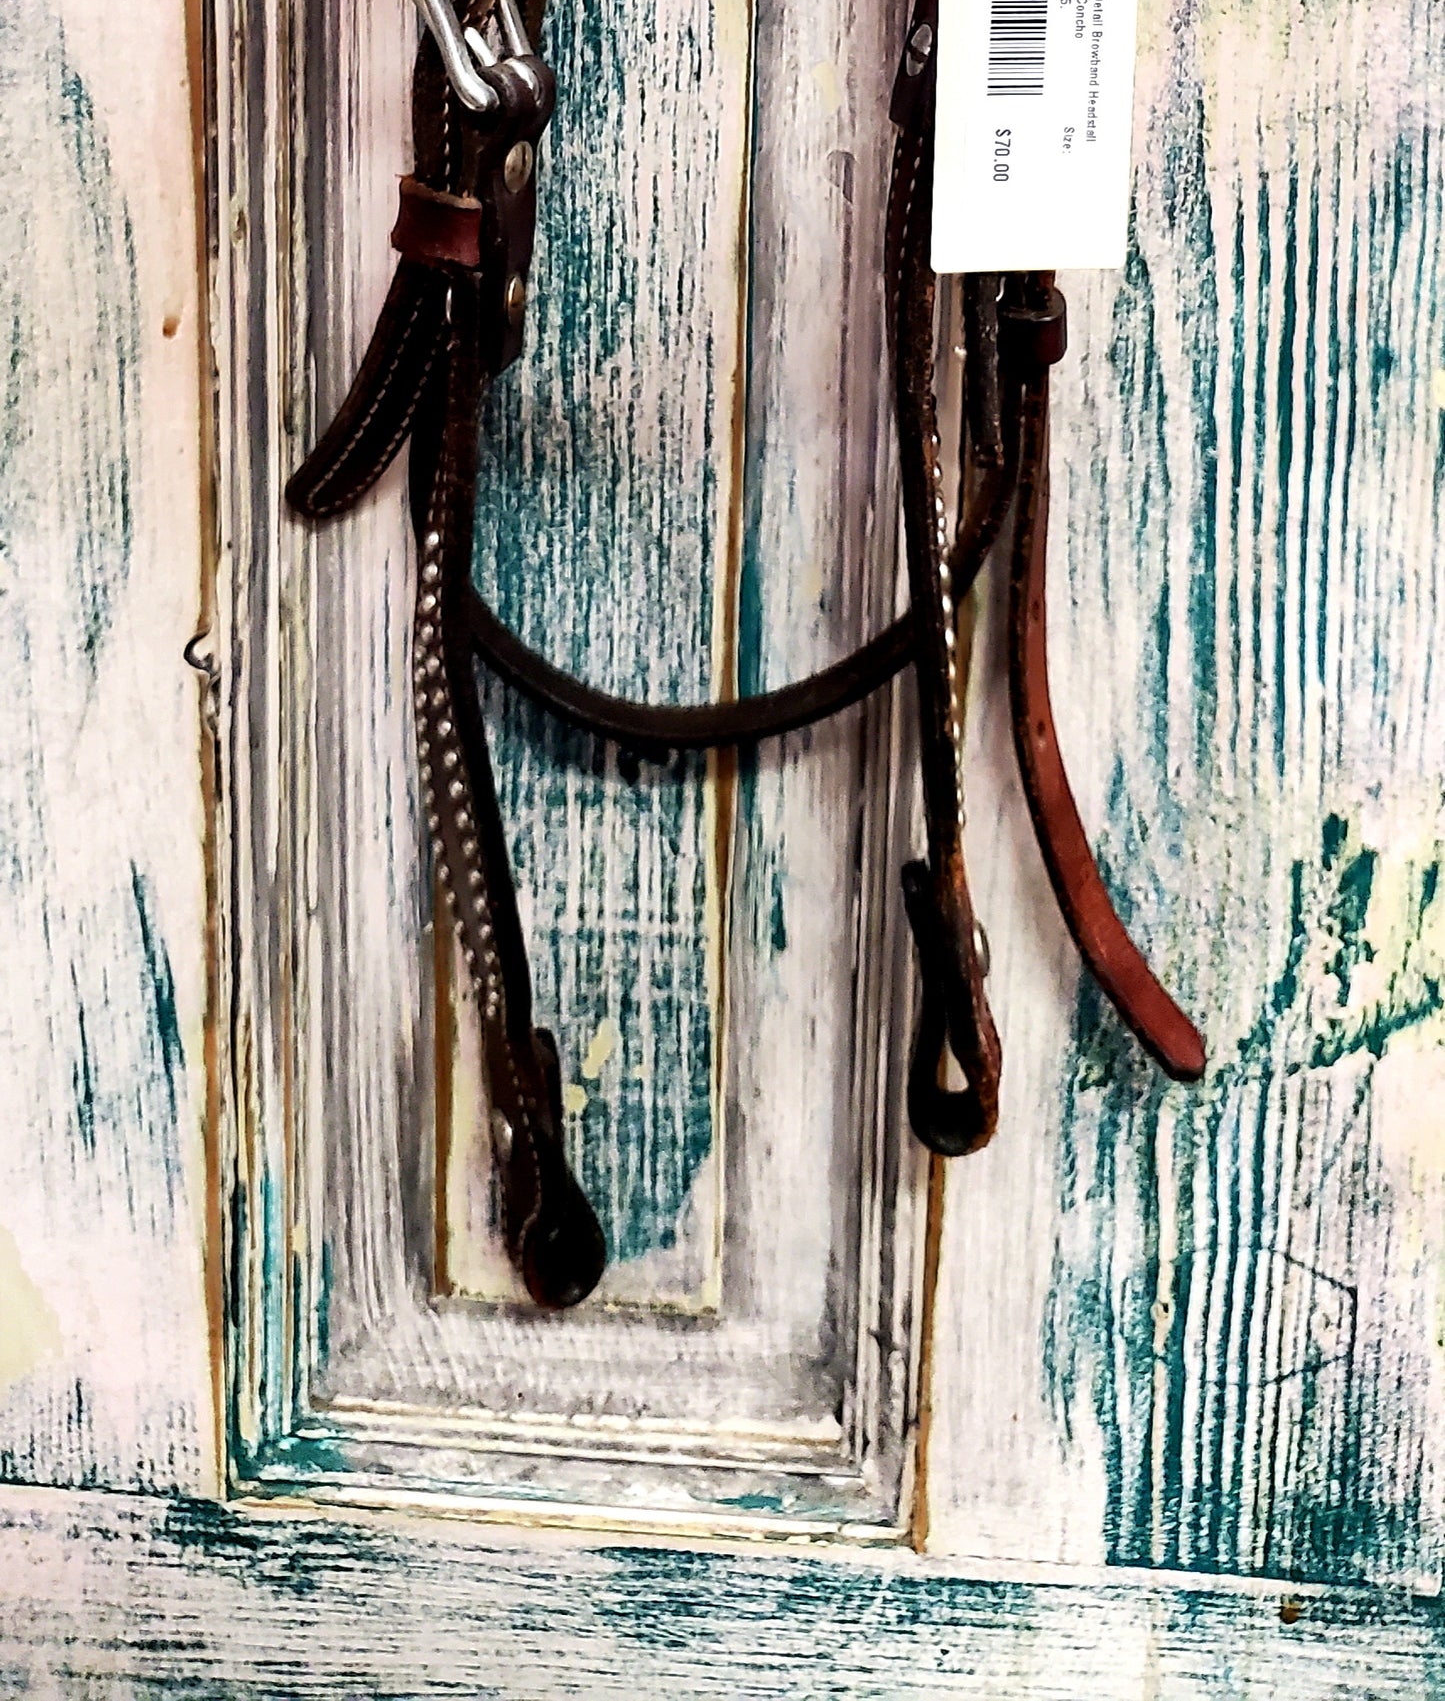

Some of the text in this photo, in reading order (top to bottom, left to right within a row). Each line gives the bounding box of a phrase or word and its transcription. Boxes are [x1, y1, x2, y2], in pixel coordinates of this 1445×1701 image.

[1088, 30, 1103, 86] Browband
[1062, 126, 1076, 154] Size:
[1085, 90, 1100, 142] Headstall
[992, 128, 1012, 182] $70.00
